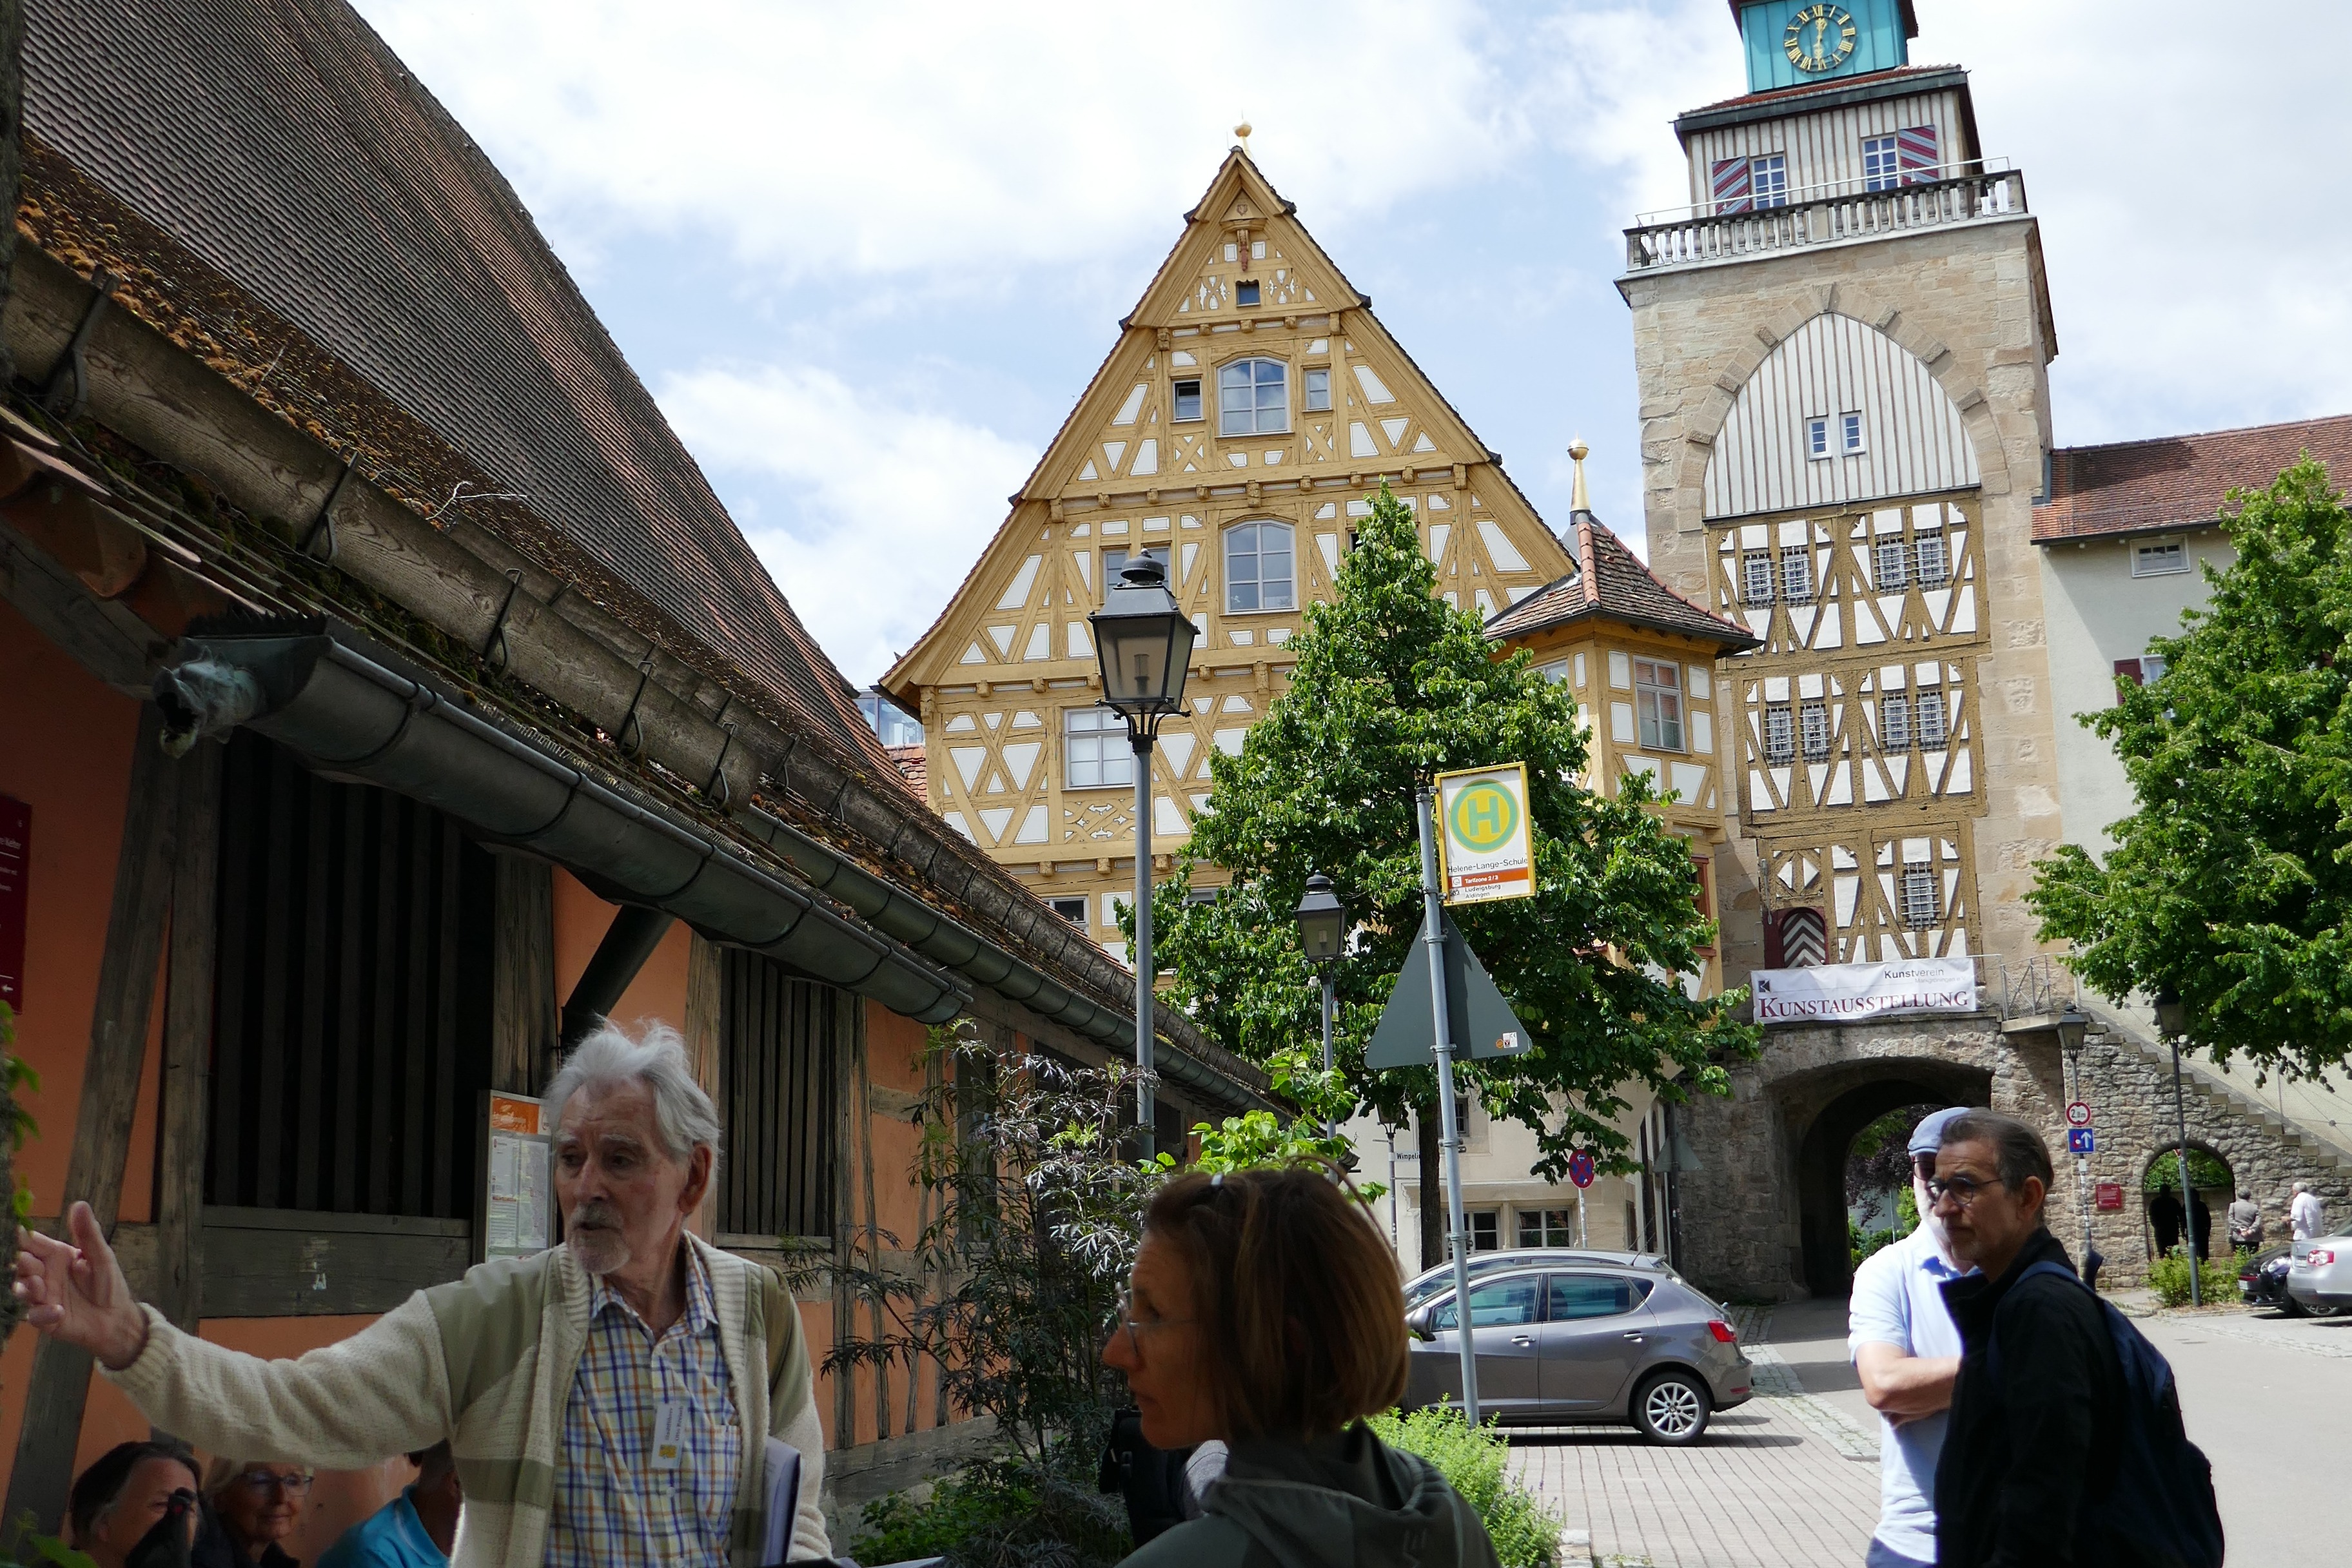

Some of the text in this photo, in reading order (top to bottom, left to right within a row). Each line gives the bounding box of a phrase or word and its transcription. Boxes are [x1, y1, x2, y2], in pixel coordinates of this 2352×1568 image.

[1467, 795, 1501, 837] H
[1448, 857, 1528, 874] Helene-Lange-Schule
[1465, 884, 1501, 893] Ludwigsburg
[1465, 891, 1491, 899] Aldingen
[1884, 967, 1944, 979] Kunstverein
[1759, 990, 1968, 1018] KUNSTAUSSTELLUNG
[1396, 1152, 1420, 1161] Wimpeli
